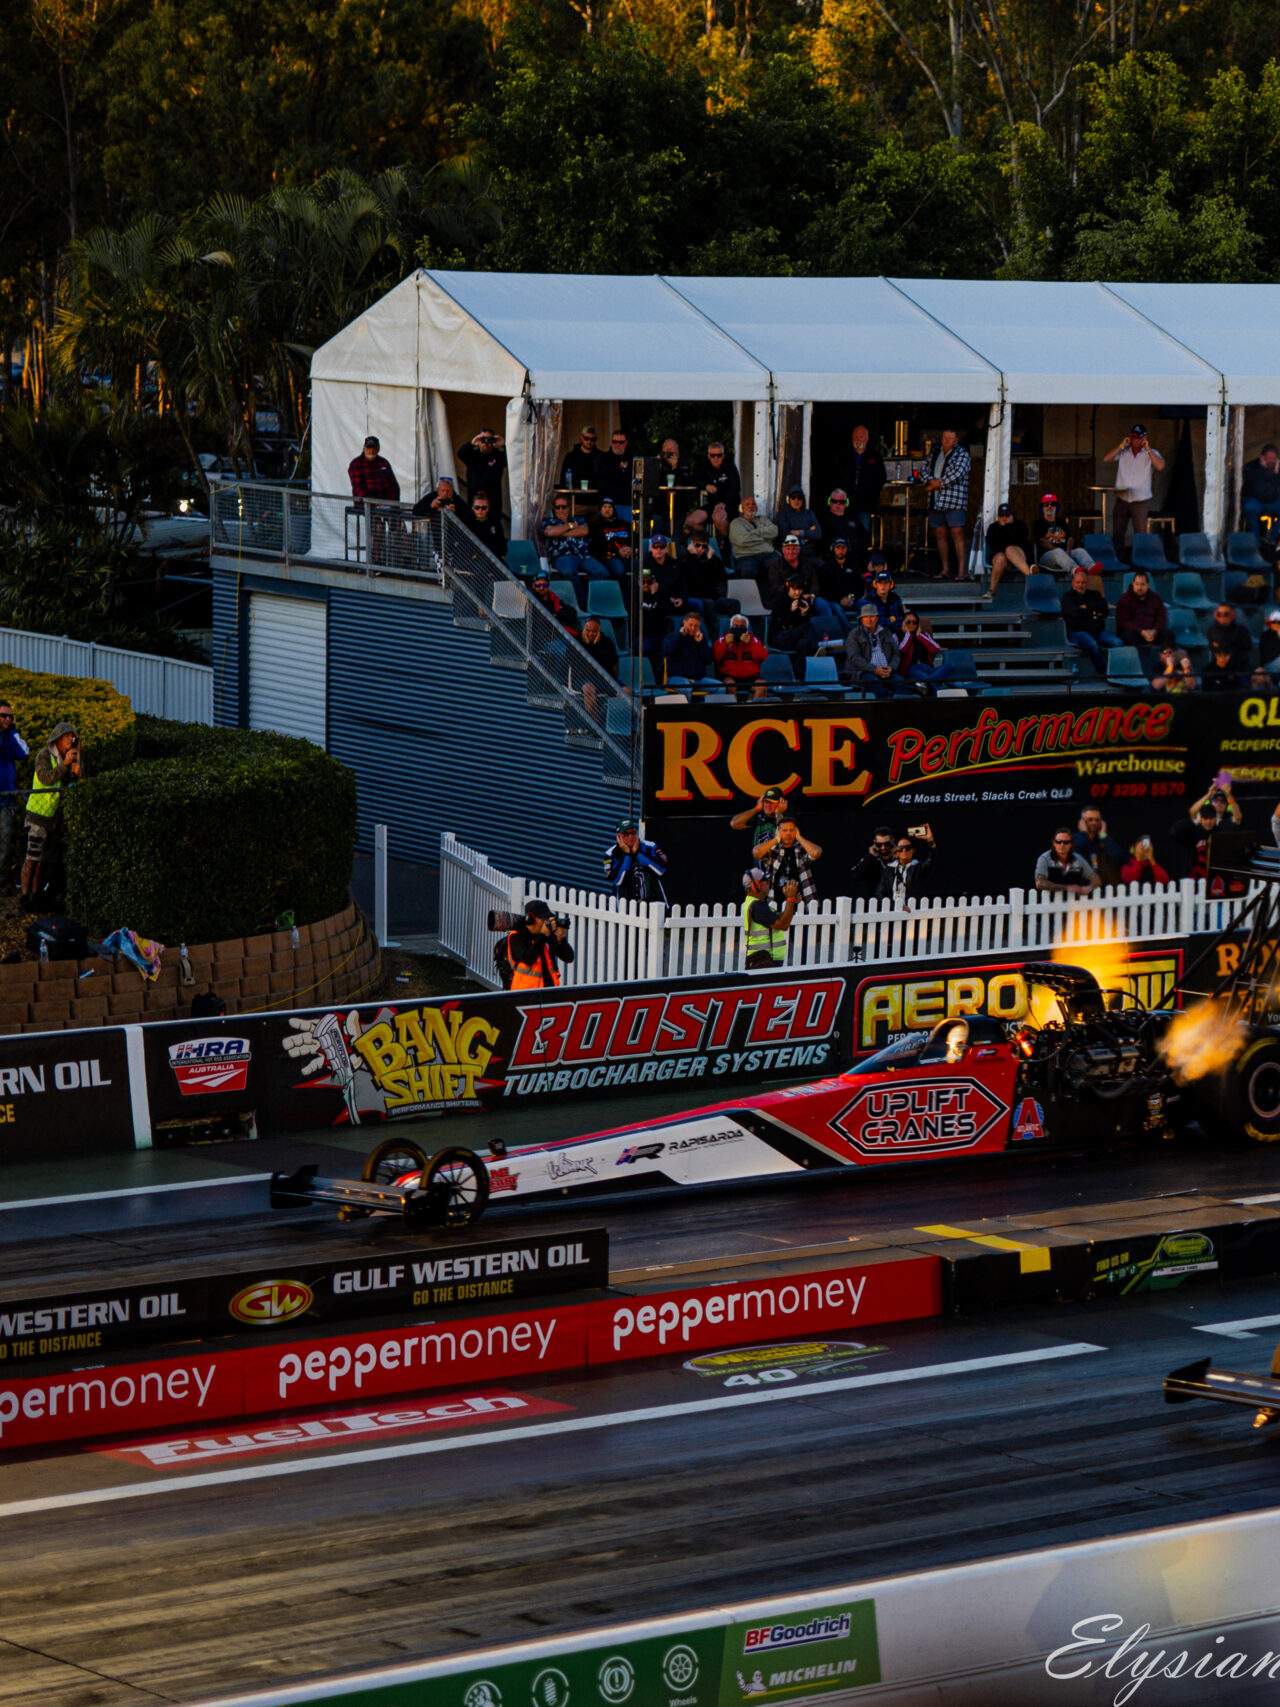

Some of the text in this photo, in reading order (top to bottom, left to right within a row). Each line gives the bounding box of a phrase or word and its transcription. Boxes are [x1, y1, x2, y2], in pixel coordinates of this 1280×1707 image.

[889, 703, 1174, 783] Performance
[656, 718, 873, 801] RCE
[1075, 754, 1187, 777] Warehouse
[899, 787, 1073, 804] 42 Moss Street, Slacks Creek QLD
[1090, 782, 1186, 798] 07 3299 5570
[508, 978, 846, 1070] BOOSTED
[176, 1040, 244, 1060] IHRA
[354, 1006, 501, 1087] BANG
[54, 1059, 112, 1090] OIL
[188, 1063, 234, 1074] AUSTRALIA
[503, 1042, 831, 1097] TURBOCHARGER SYSTEMS
[379, 1064, 484, 1109] SHIFT
[866, 1086, 973, 1118] UPLIFT
[391, 1101, 480, 1116] PERFORMANCE SHIFTERS
[668, 1128, 745, 1151] RAPISARDA
[861, 1112, 977, 1145] CRANES
[333, 1242, 590, 1295] GULF WESTERN OIL
[1096, 1251, 1130, 1273] FIND US ON
[413, 1278, 515, 1306] GO THE DISTANCE
[0, 1292, 187, 1337] WESTERN OIL
[613, 1275, 867, 1351] peppermoney
[12, 1331, 103, 1358] THE DISTANCE
[279, 1318, 557, 1399] peppermoney
[723, 1368, 798, 1387] 40
[118, 1396, 529, 1465] FuelTech
[744, 1612, 851, 1649] BFGoodrich
[769, 1658, 857, 1687] MICHELIN
[669, 1695, 698, 1707] Wheels
